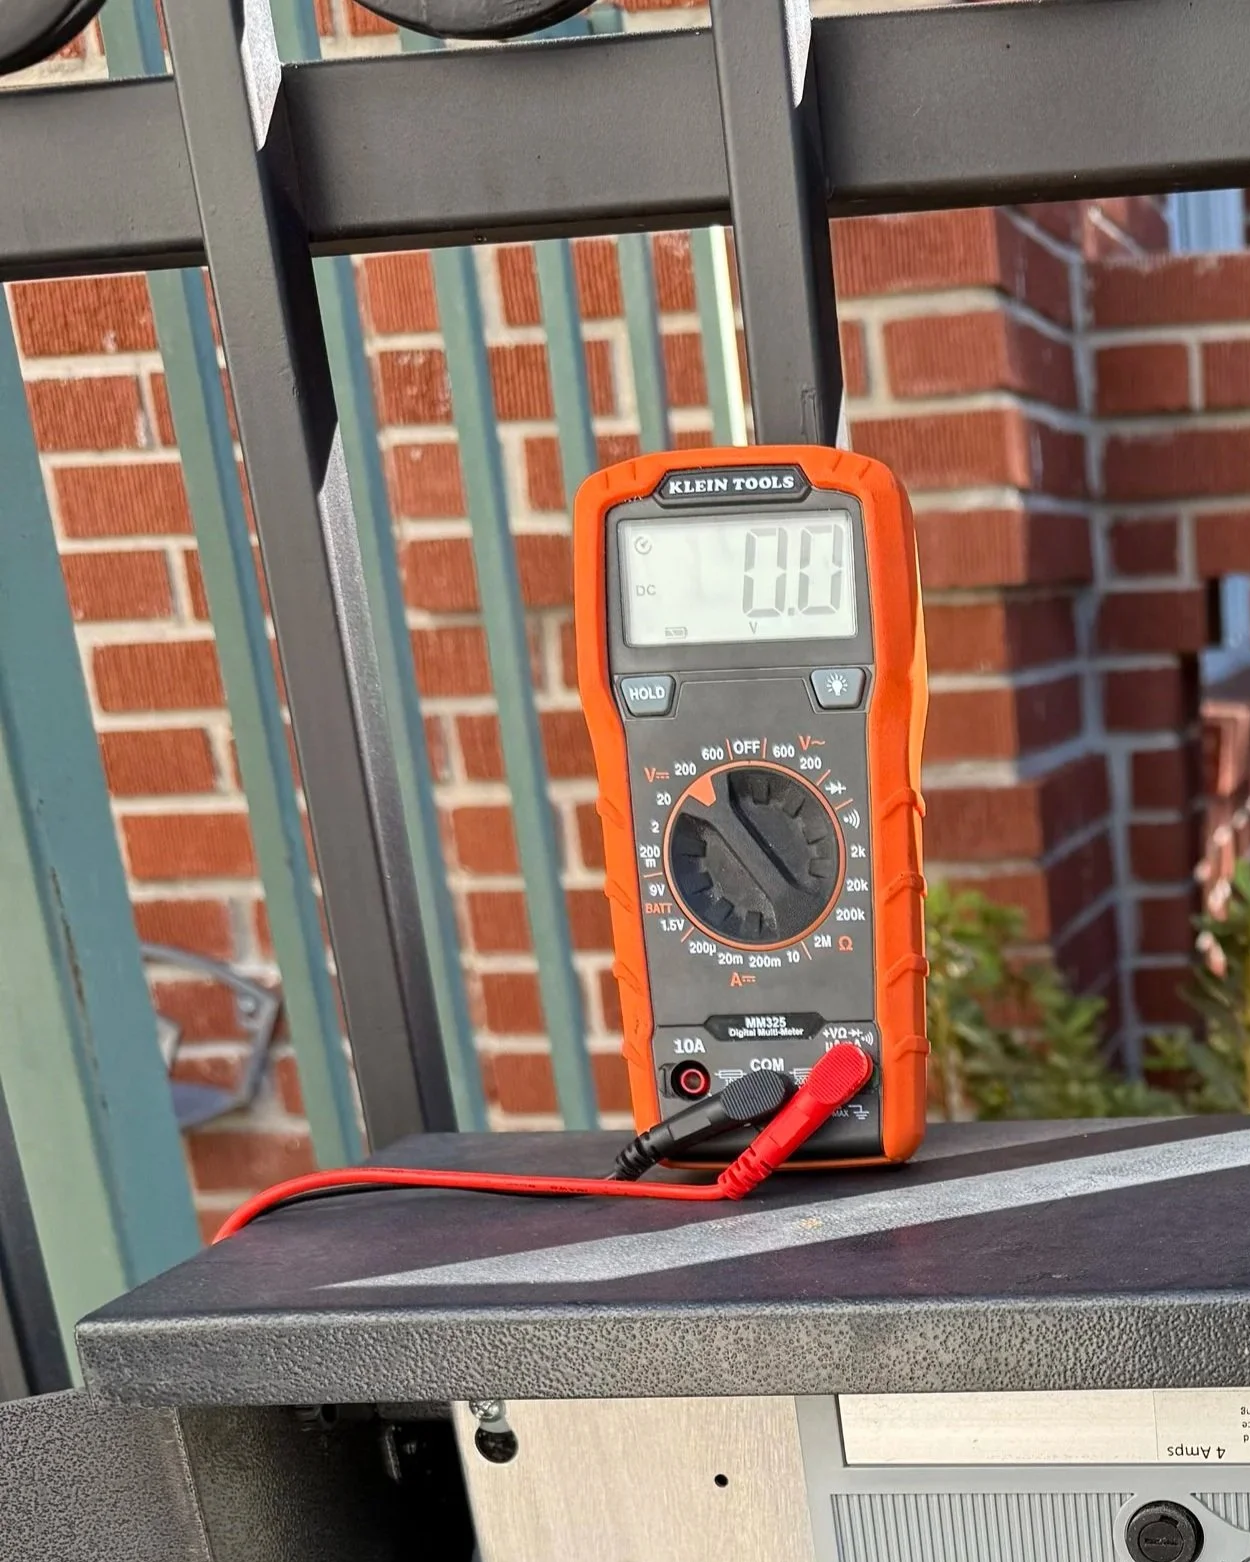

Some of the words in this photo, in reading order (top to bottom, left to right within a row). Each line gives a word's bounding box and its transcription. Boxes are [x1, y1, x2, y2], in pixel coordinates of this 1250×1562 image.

[669, 478, 728, 495] KLEIN
[733, 476, 795, 491] TOOLS
[742, 525, 844, 618] 0.0
[636, 585, 656, 597] DC
[629, 686, 665, 701] HOLD
[733, 740, 760, 754] OFF
[773, 746, 795, 758] 600
[702, 748, 724, 760] 600
[675, 763, 697, 776] 200
[800, 757, 822, 770] 200
[656, 793, 672, 806] 20
[651, 822, 660, 833] 2
[640, 846, 660, 858] 200
[851, 846, 866, 858] 2k
[650, 885, 665, 897] 9V
[846, 880, 869, 892] 20k
[645, 903, 673, 914] BATT
[836, 909, 865, 921] 200k
[661, 920, 684, 932] 1.5V
[814, 935, 832, 947] 2M
[718, 952, 744, 965] 20m
[749, 956, 781, 968] 200m
[787, 951, 800, 963] 10
[745, 1017, 787, 1028] MM325
[728, 1027, 756, 1039] Digital
[757, 1026, 804, 1038] Multi-Meter
[674, 1039, 706, 1053] 10A
[750, 1058, 785, 1072] COM
[1167, 1445, 1212, 1460] Amps
[1215, 1446, 1226, 1459] 4
